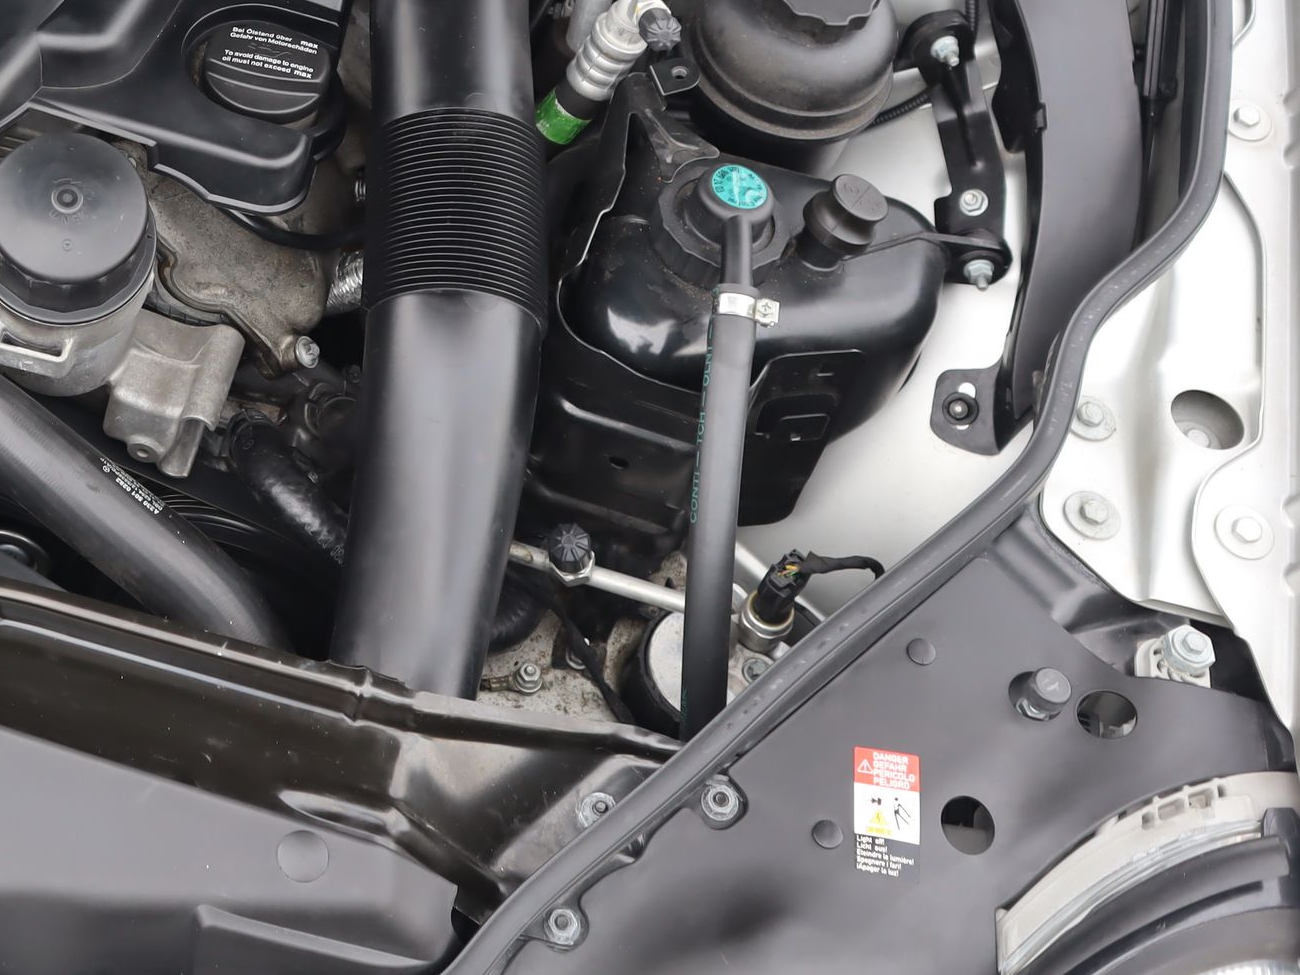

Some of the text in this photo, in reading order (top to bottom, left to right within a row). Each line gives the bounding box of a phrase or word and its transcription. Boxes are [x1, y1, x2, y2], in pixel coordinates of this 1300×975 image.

[230, 32, 253, 40] Gefahr
[268, 38, 317, 54] Motorschäden
[276, 34, 292, 42] über
[300, 40, 318, 49] max
[232, 57, 250, 65] must
[251, 60, 263, 68] not
[264, 63, 291, 74] exceed
[294, 69, 312, 79] max
[234, 51, 254, 59] avoid
[254, 53, 281, 65] damage
[290, 62, 314, 73] engine
[690, 471, 700, 524] CONTI
[696, 412, 706, 444] TCH
[142, 500, 160, 515] A230
[873, 752, 909, 765] DANGER
[873, 760, 907, 773] GEFAHR
[874, 768, 915, 782] PERICOLO
[874, 777, 910, 789] PELIGRO
